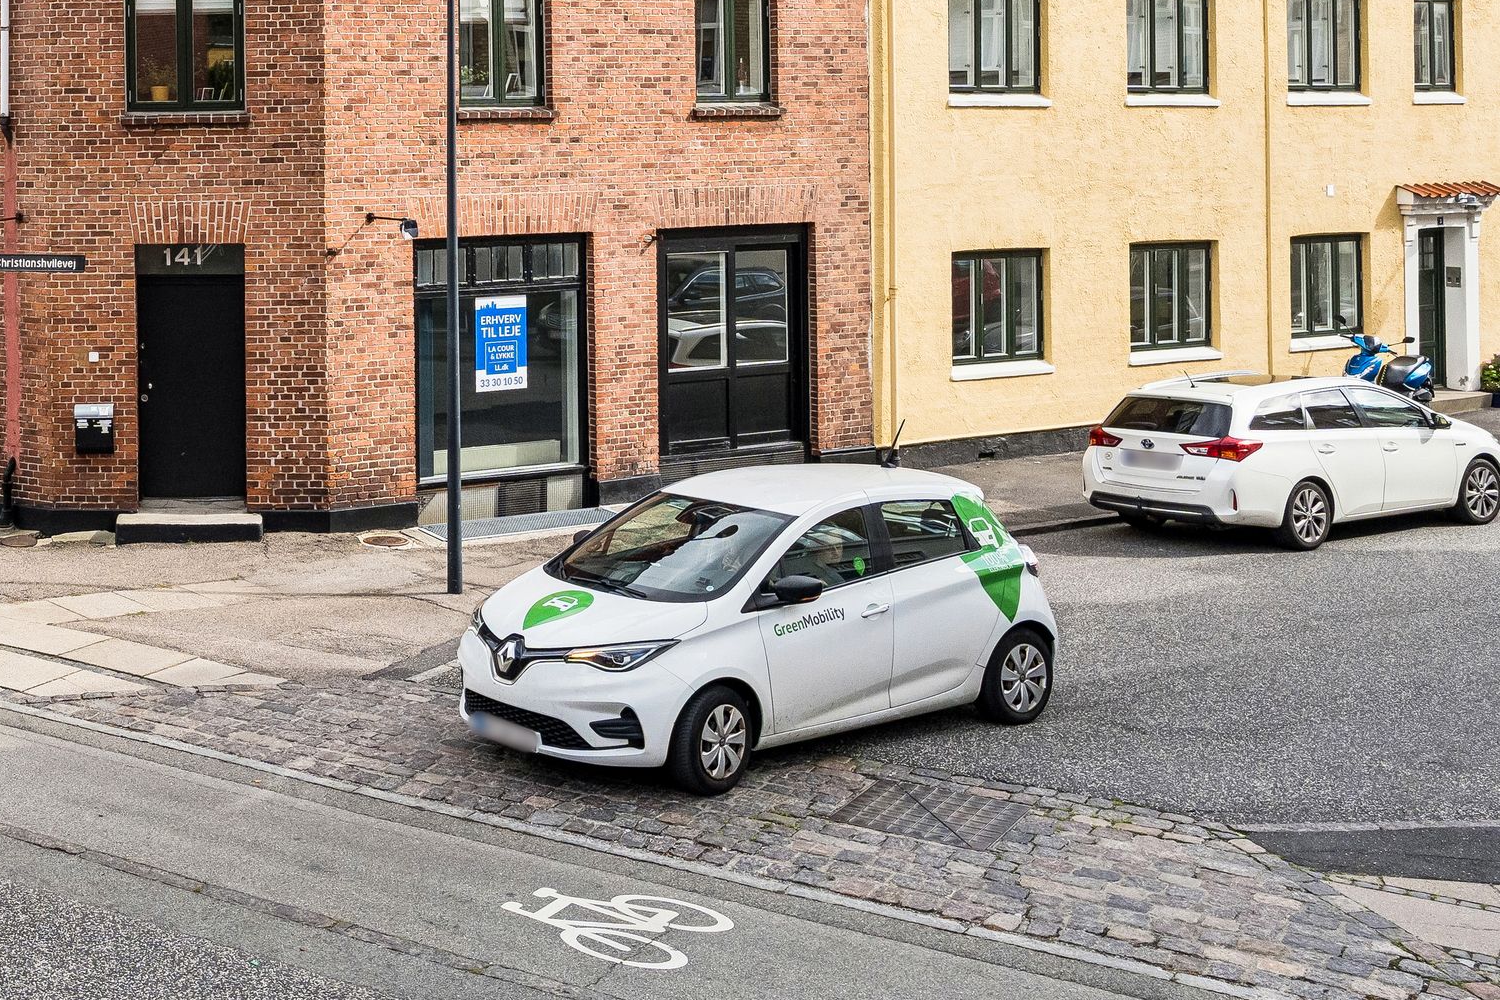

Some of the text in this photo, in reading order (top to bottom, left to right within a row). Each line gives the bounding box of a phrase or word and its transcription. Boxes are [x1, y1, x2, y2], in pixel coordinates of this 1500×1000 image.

[163, 247, 202, 266] 141
[480, 314, 521, 325] ERHVERV
[481, 325, 521, 338] TIL LEJE
[497, 344, 514, 352] COUR
[480, 376, 523, 388] 33 30 10 50
[773, 607, 845, 637] GreenMobility
